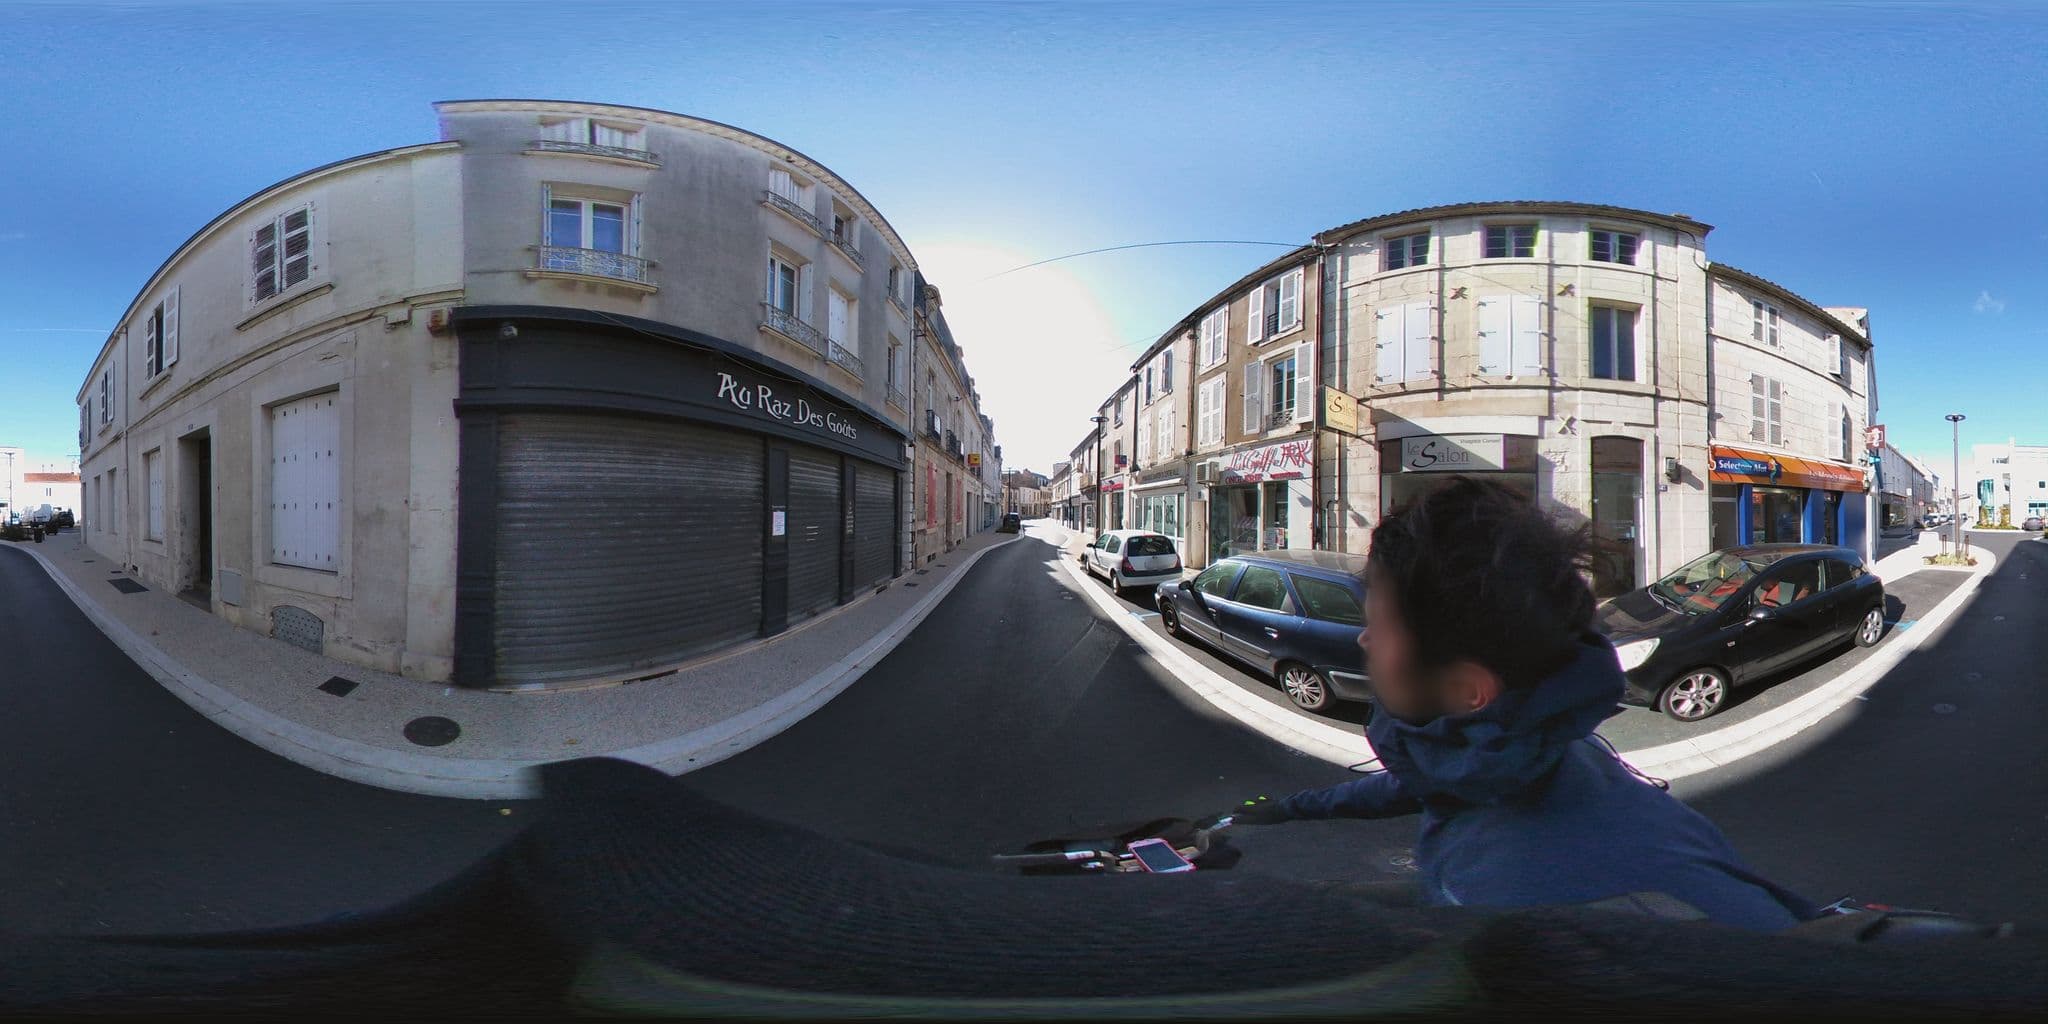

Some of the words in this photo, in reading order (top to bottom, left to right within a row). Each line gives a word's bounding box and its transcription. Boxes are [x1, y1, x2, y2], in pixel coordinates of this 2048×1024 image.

[718, 372, 750, 410] Au
[758, 385, 791, 419] Raz
[793, 399, 824, 428] Des
[826, 412, 857, 439] Goûts
[1411, 441, 1469, 468] Salon
